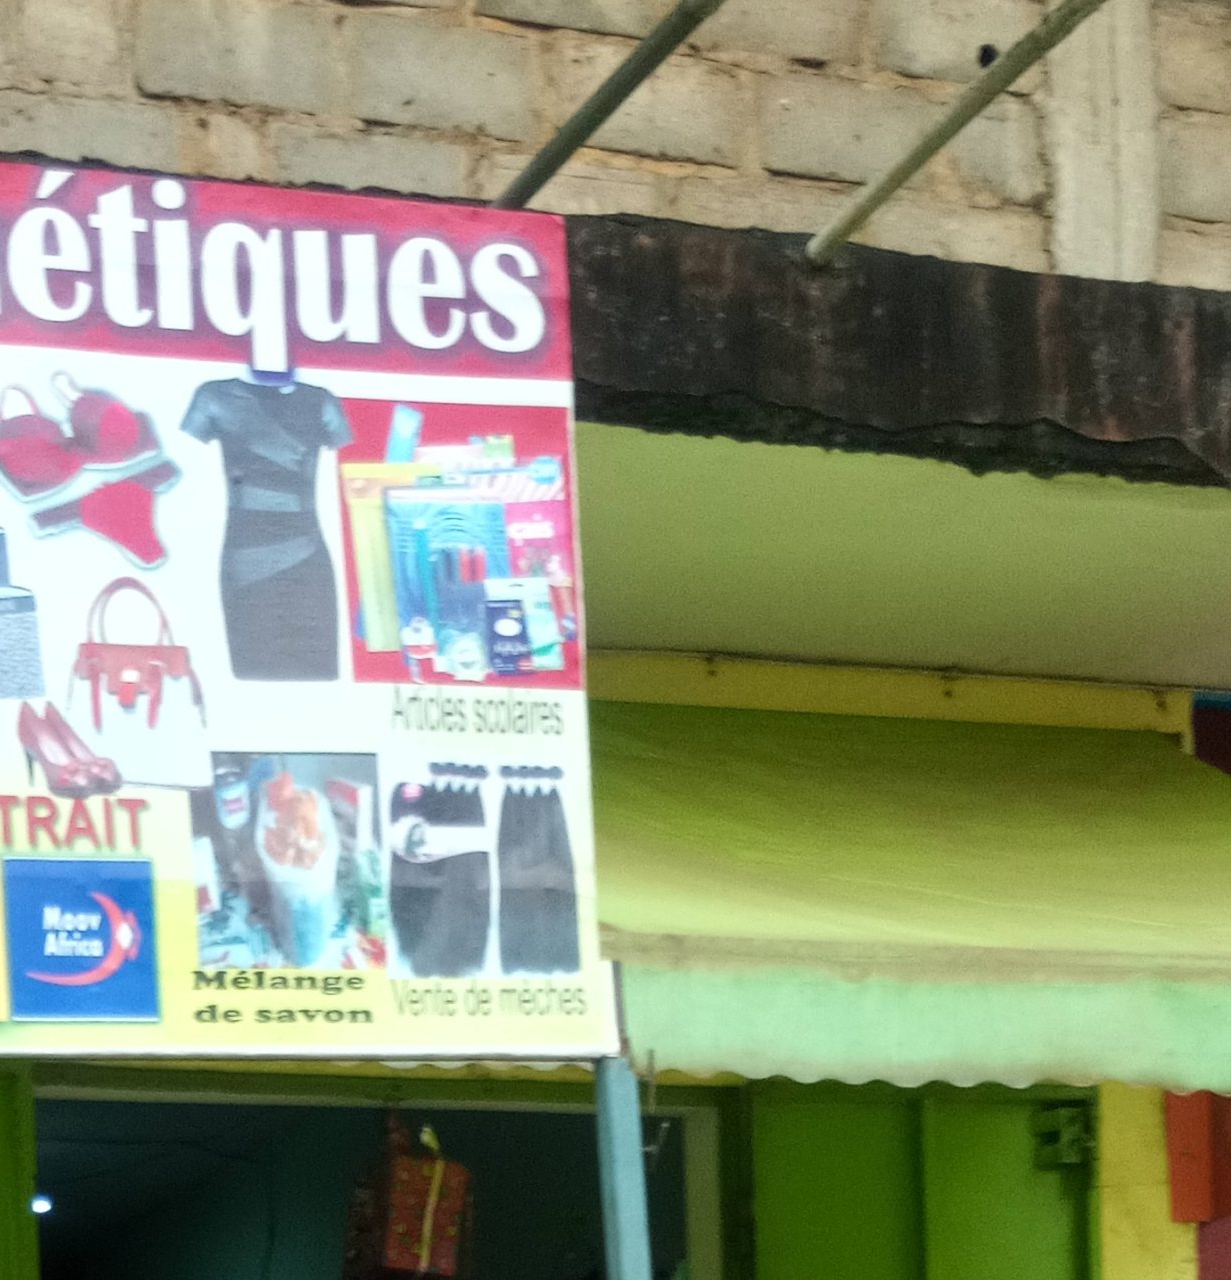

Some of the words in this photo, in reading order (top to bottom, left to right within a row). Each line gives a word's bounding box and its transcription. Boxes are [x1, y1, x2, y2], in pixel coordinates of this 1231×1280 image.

[391, 686, 468, 731] Articles
[472, 689, 566, 736] scolaires
[42, 905, 102, 932] Moov
[44, 933, 105, 959] Africa
[191, 969, 366, 996] Mélange
[391, 979, 458, 1017] Vente
[463, 979, 493, 1017] de
[194, 1004, 243, 1025] de
[254, 1005, 375, 1025] savon
